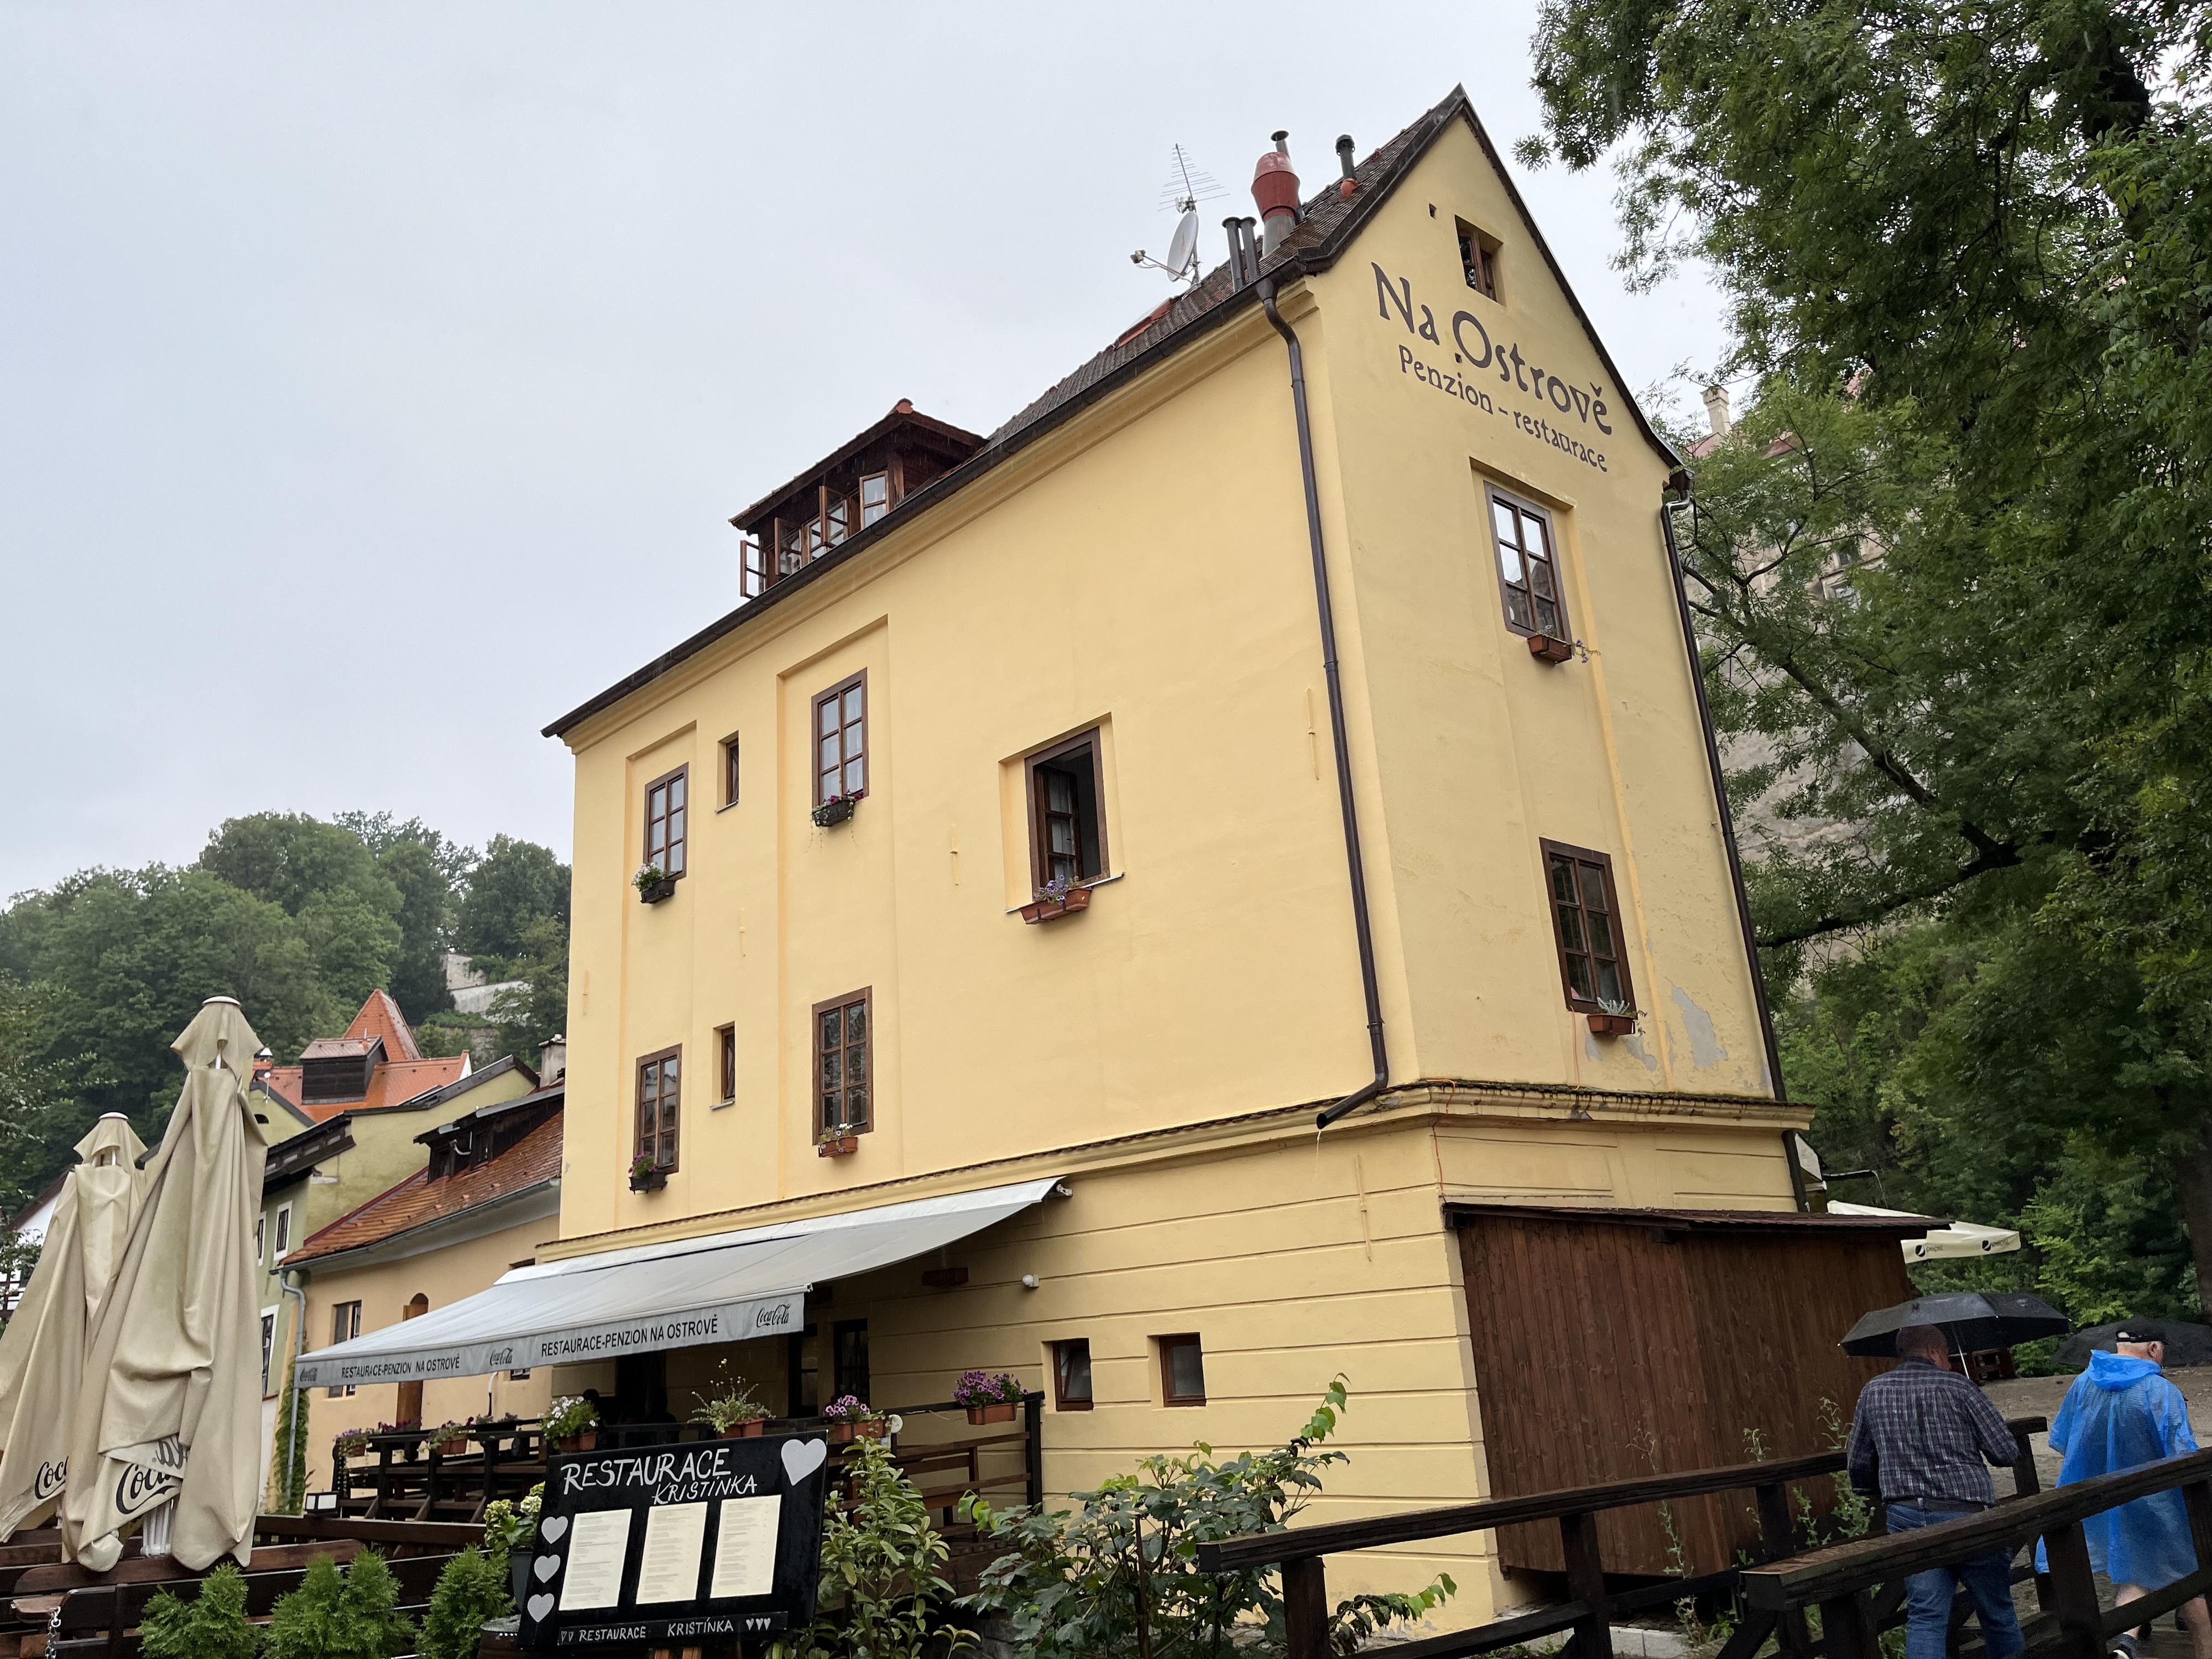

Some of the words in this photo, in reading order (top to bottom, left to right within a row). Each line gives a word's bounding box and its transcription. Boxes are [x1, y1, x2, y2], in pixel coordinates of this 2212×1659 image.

[1371, 262, 1439, 345] Na
[1452, 310, 1613, 435] Ostrově
[1399, 344, 1493, 415] Penzion
[1513, 409, 1608, 472] restaurace
[541, 1329, 647, 1357] RESTAURACE-PENZION
[650, 1324, 664, 1342] NA
[667, 1313, 718, 1339] OSTROVĚ
[341, 1361, 412, 1379] RESTAURACE-PENZION
[415, 1360, 425, 1372] NA
[561, 1448, 731, 1495] RESTAURACE
[579, 1626, 646, 1642] RESTAURACE
[667, 1617, 734, 1637] KRISTÍNKA
